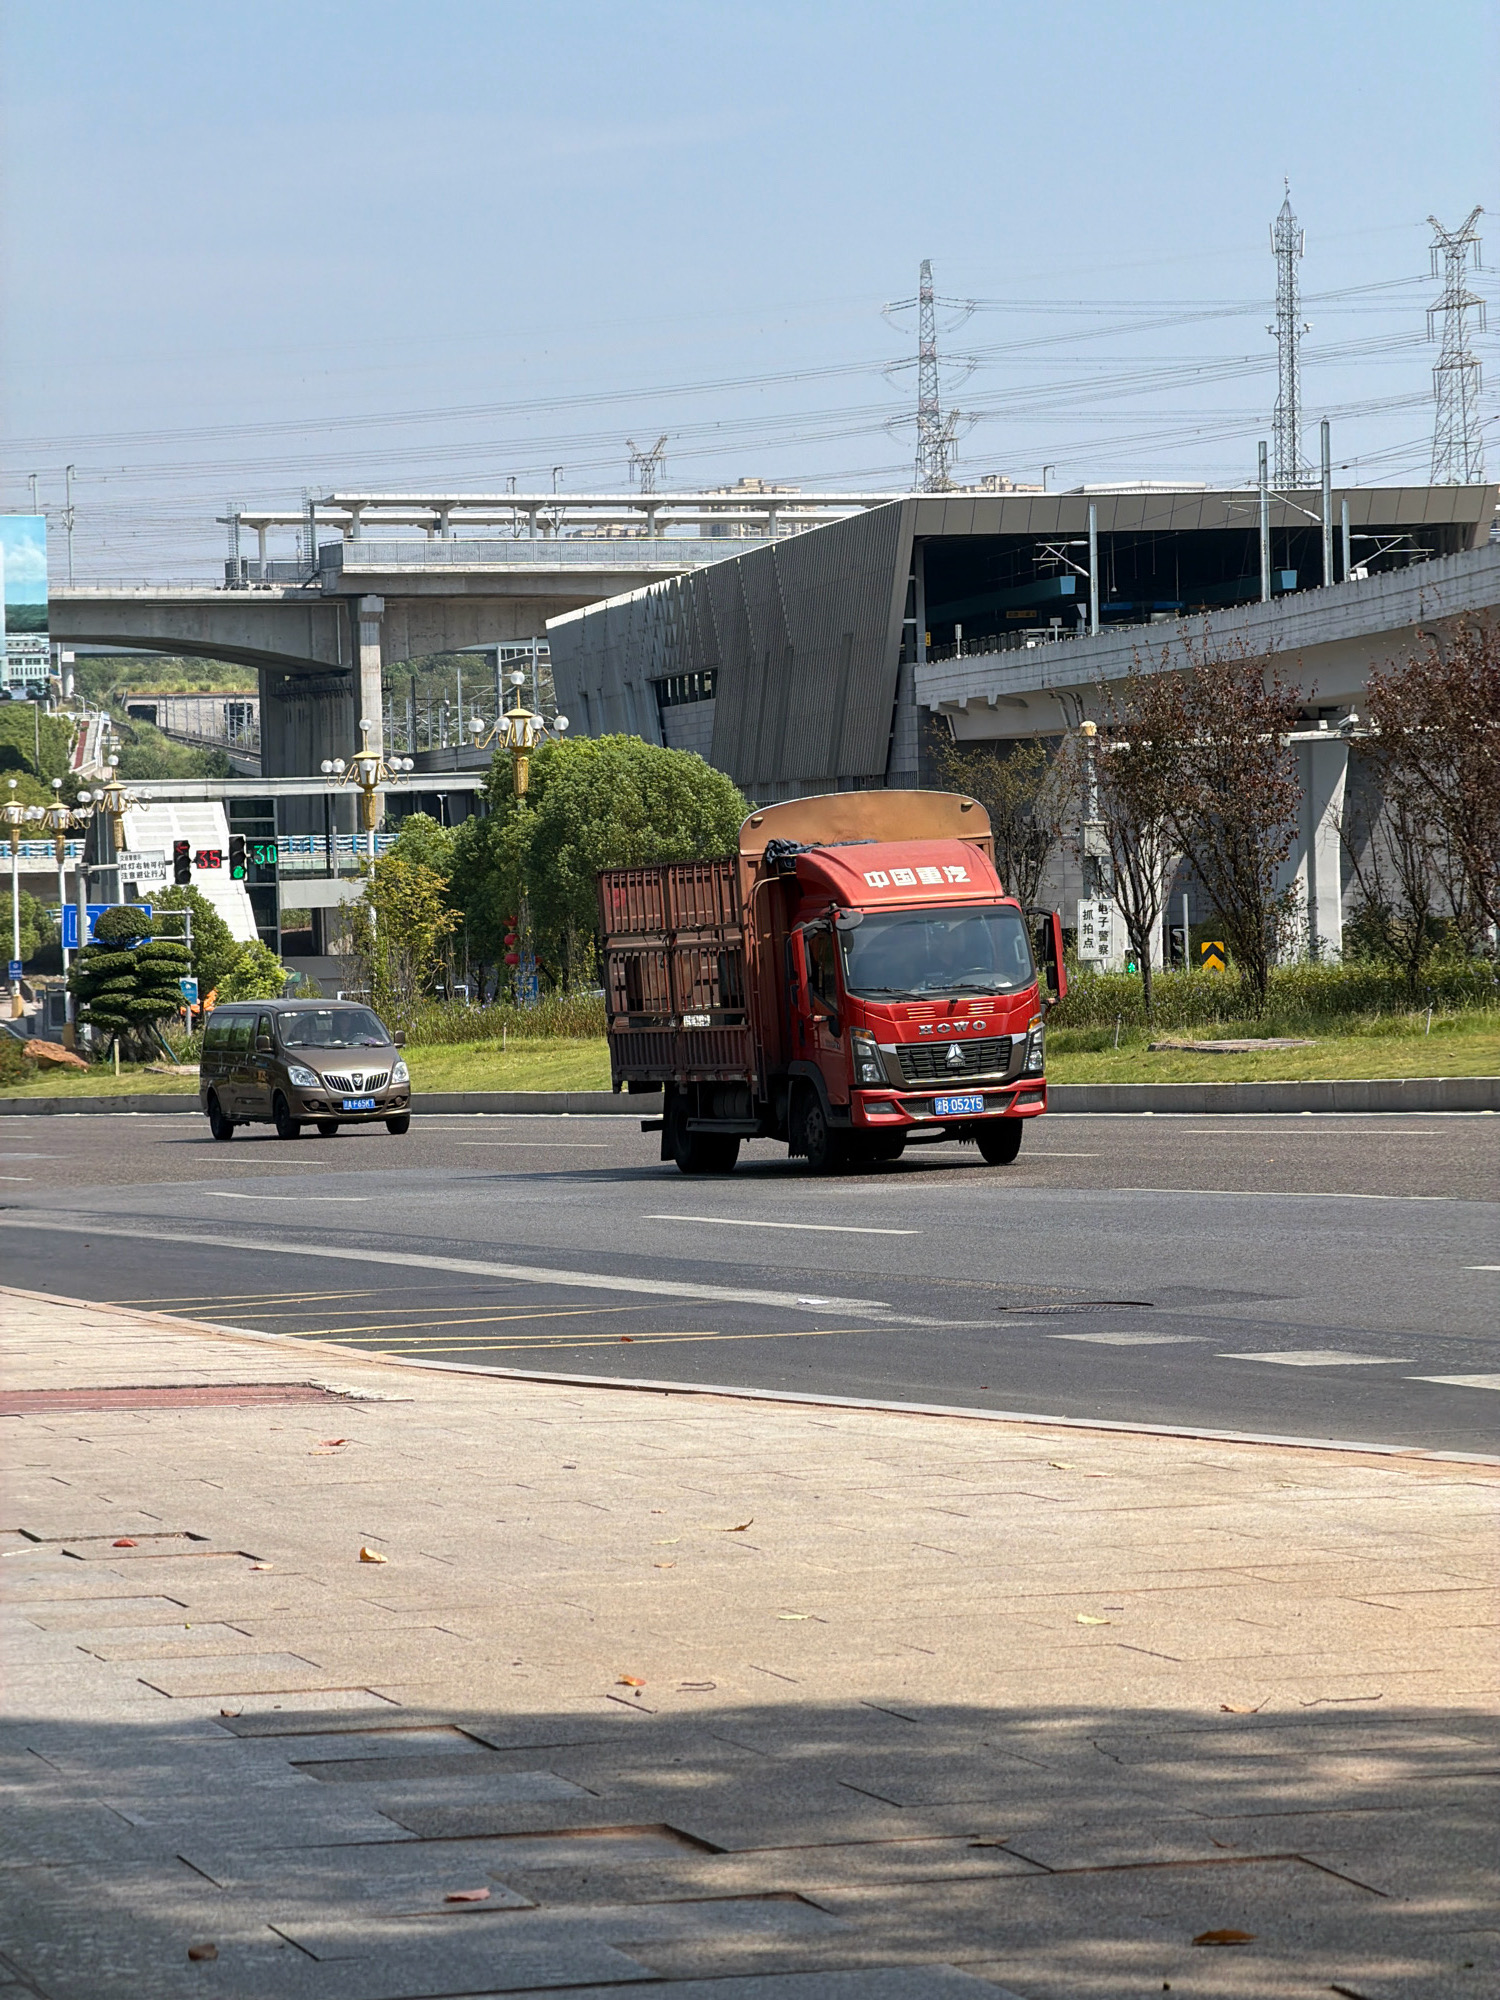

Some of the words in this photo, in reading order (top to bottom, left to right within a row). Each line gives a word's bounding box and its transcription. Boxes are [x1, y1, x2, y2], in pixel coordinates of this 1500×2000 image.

[197, 850, 221, 869] 35
[253, 844, 277, 865] 30
[120, 861, 165, 870] 红灯右转可行
[121, 870, 166, 879] 注意避让行人
[863, 865, 971, 888] 中国重汽
[1082, 909, 1094, 949] 抓拍点
[1098, 902, 1109, 955] 电子警察
[918, 1020, 987, 1035] HOWO
